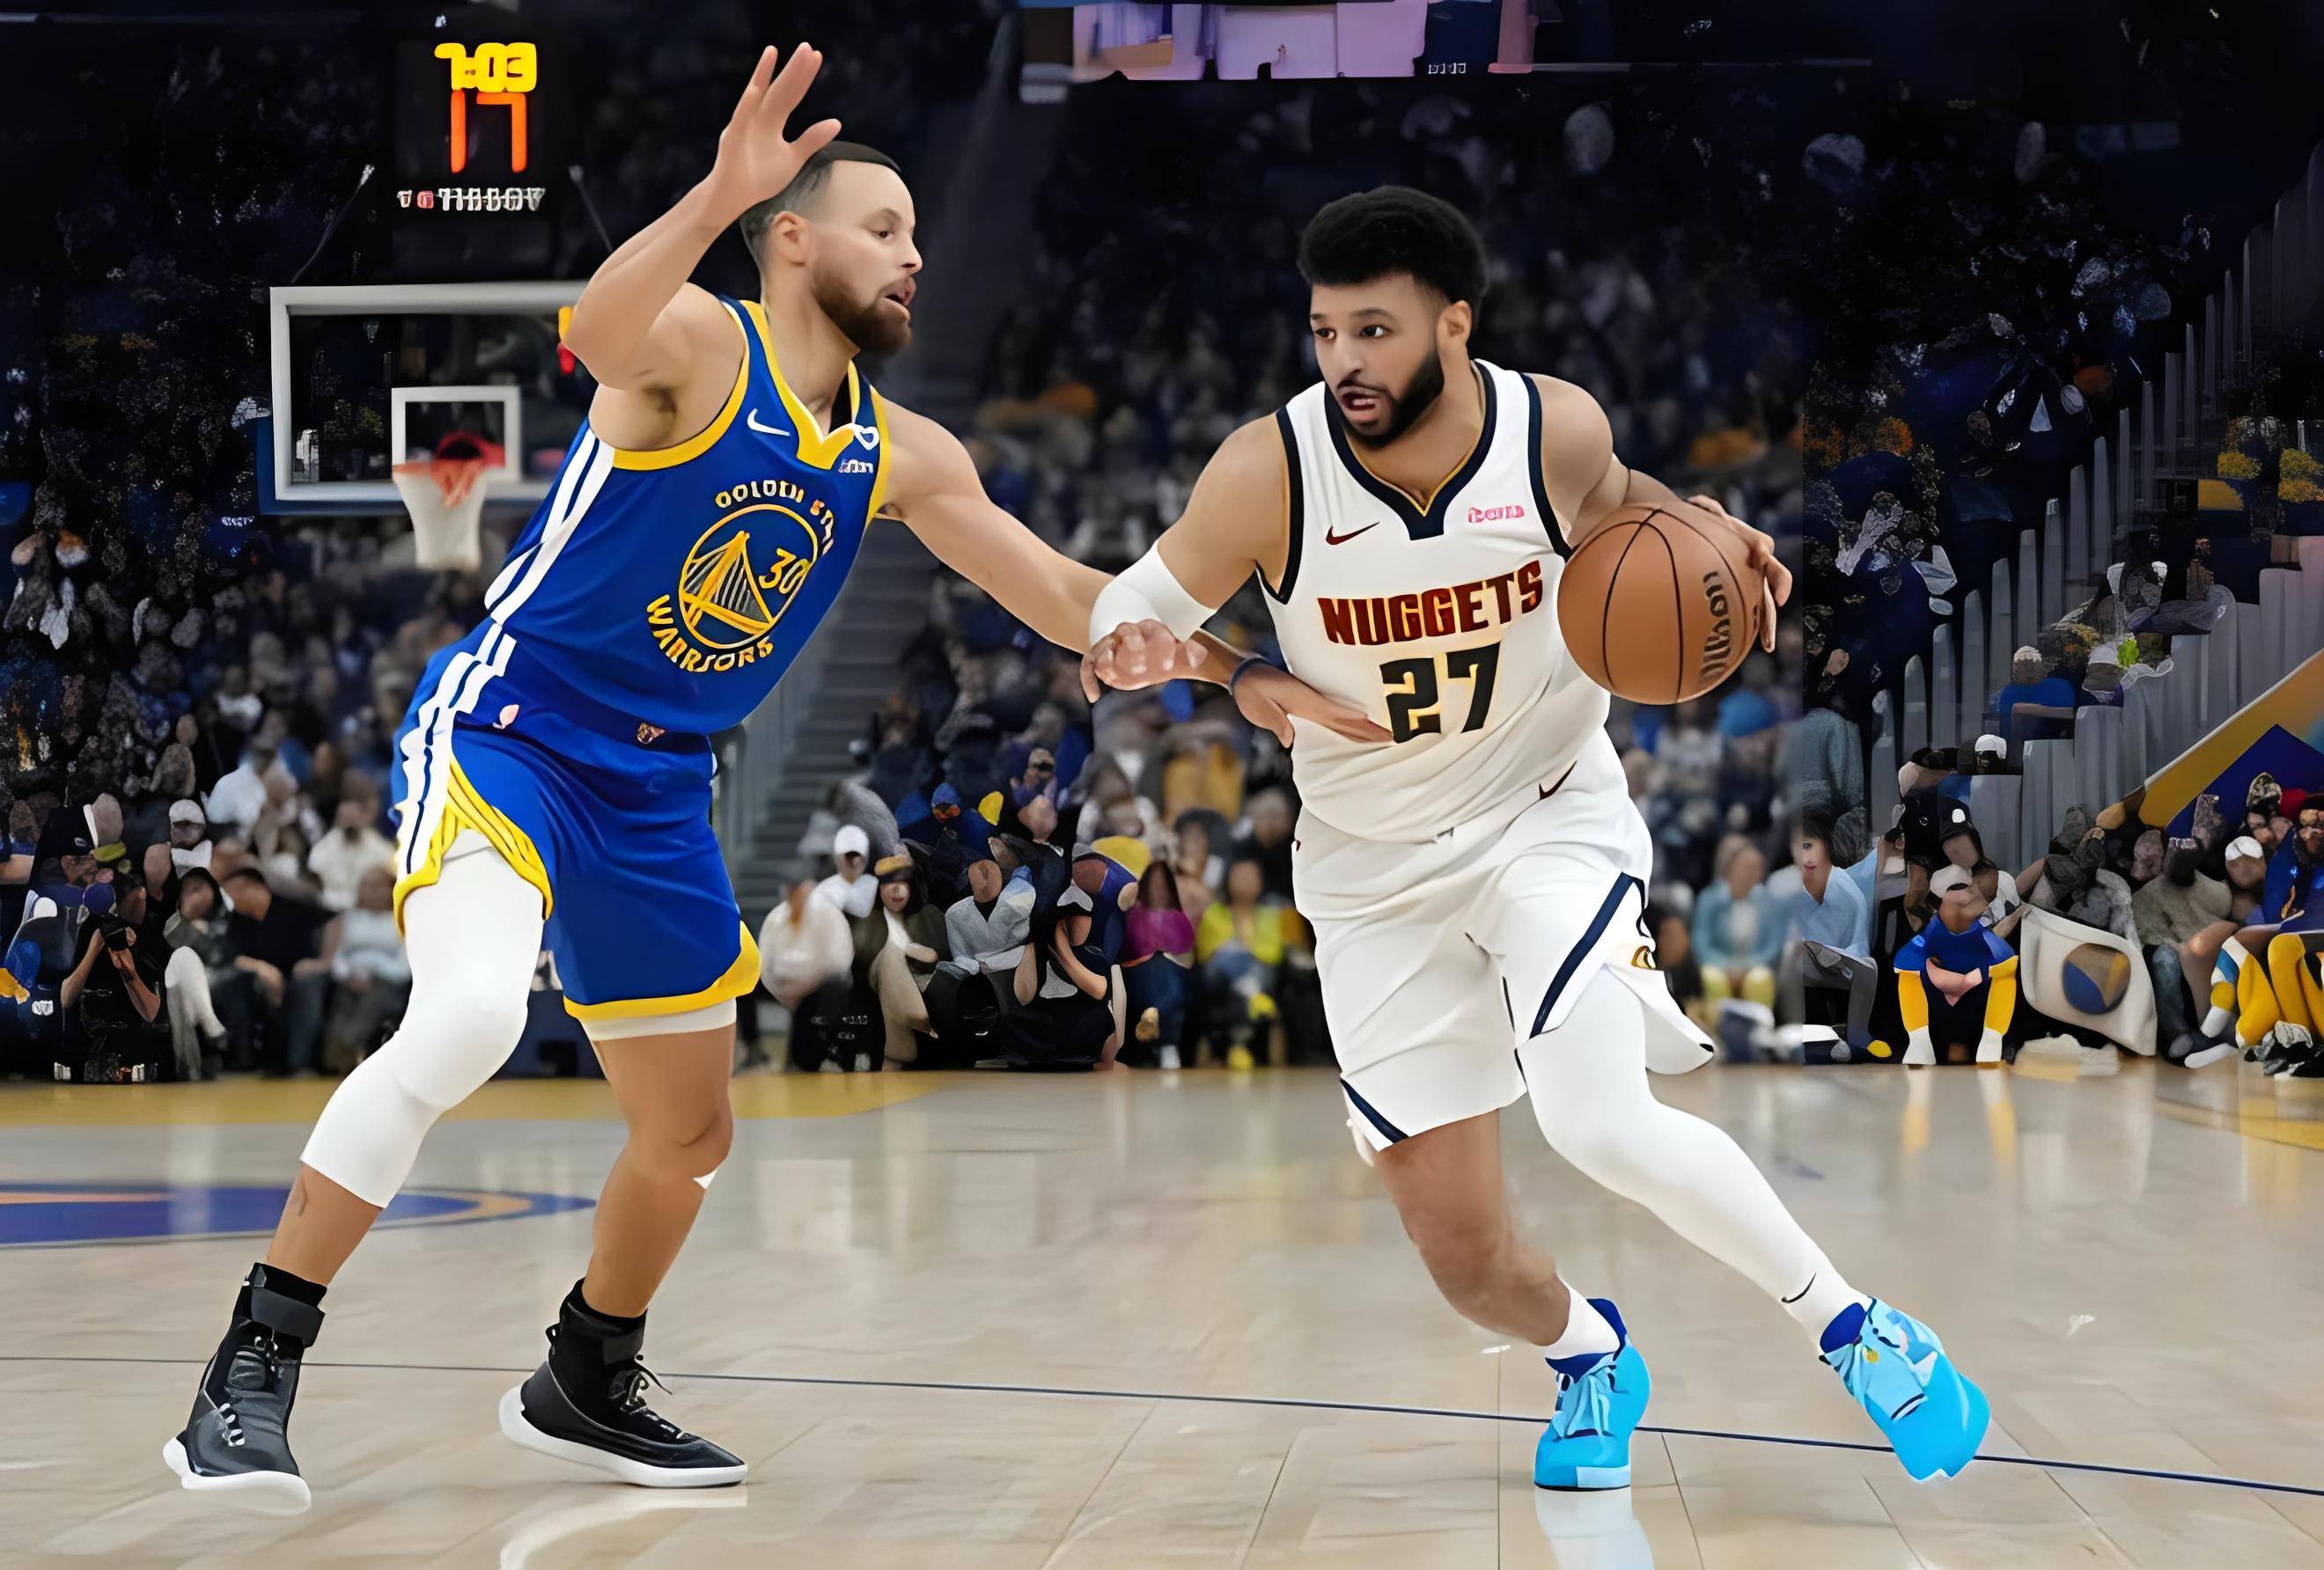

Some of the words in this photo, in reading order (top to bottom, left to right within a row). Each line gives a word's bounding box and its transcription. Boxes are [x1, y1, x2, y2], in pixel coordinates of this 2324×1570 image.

[450, 89, 527, 173] 17
[759, 547, 810, 594] 30
[1317, 560, 1543, 646] NUGGETS
[1379, 641, 1501, 745] 27
